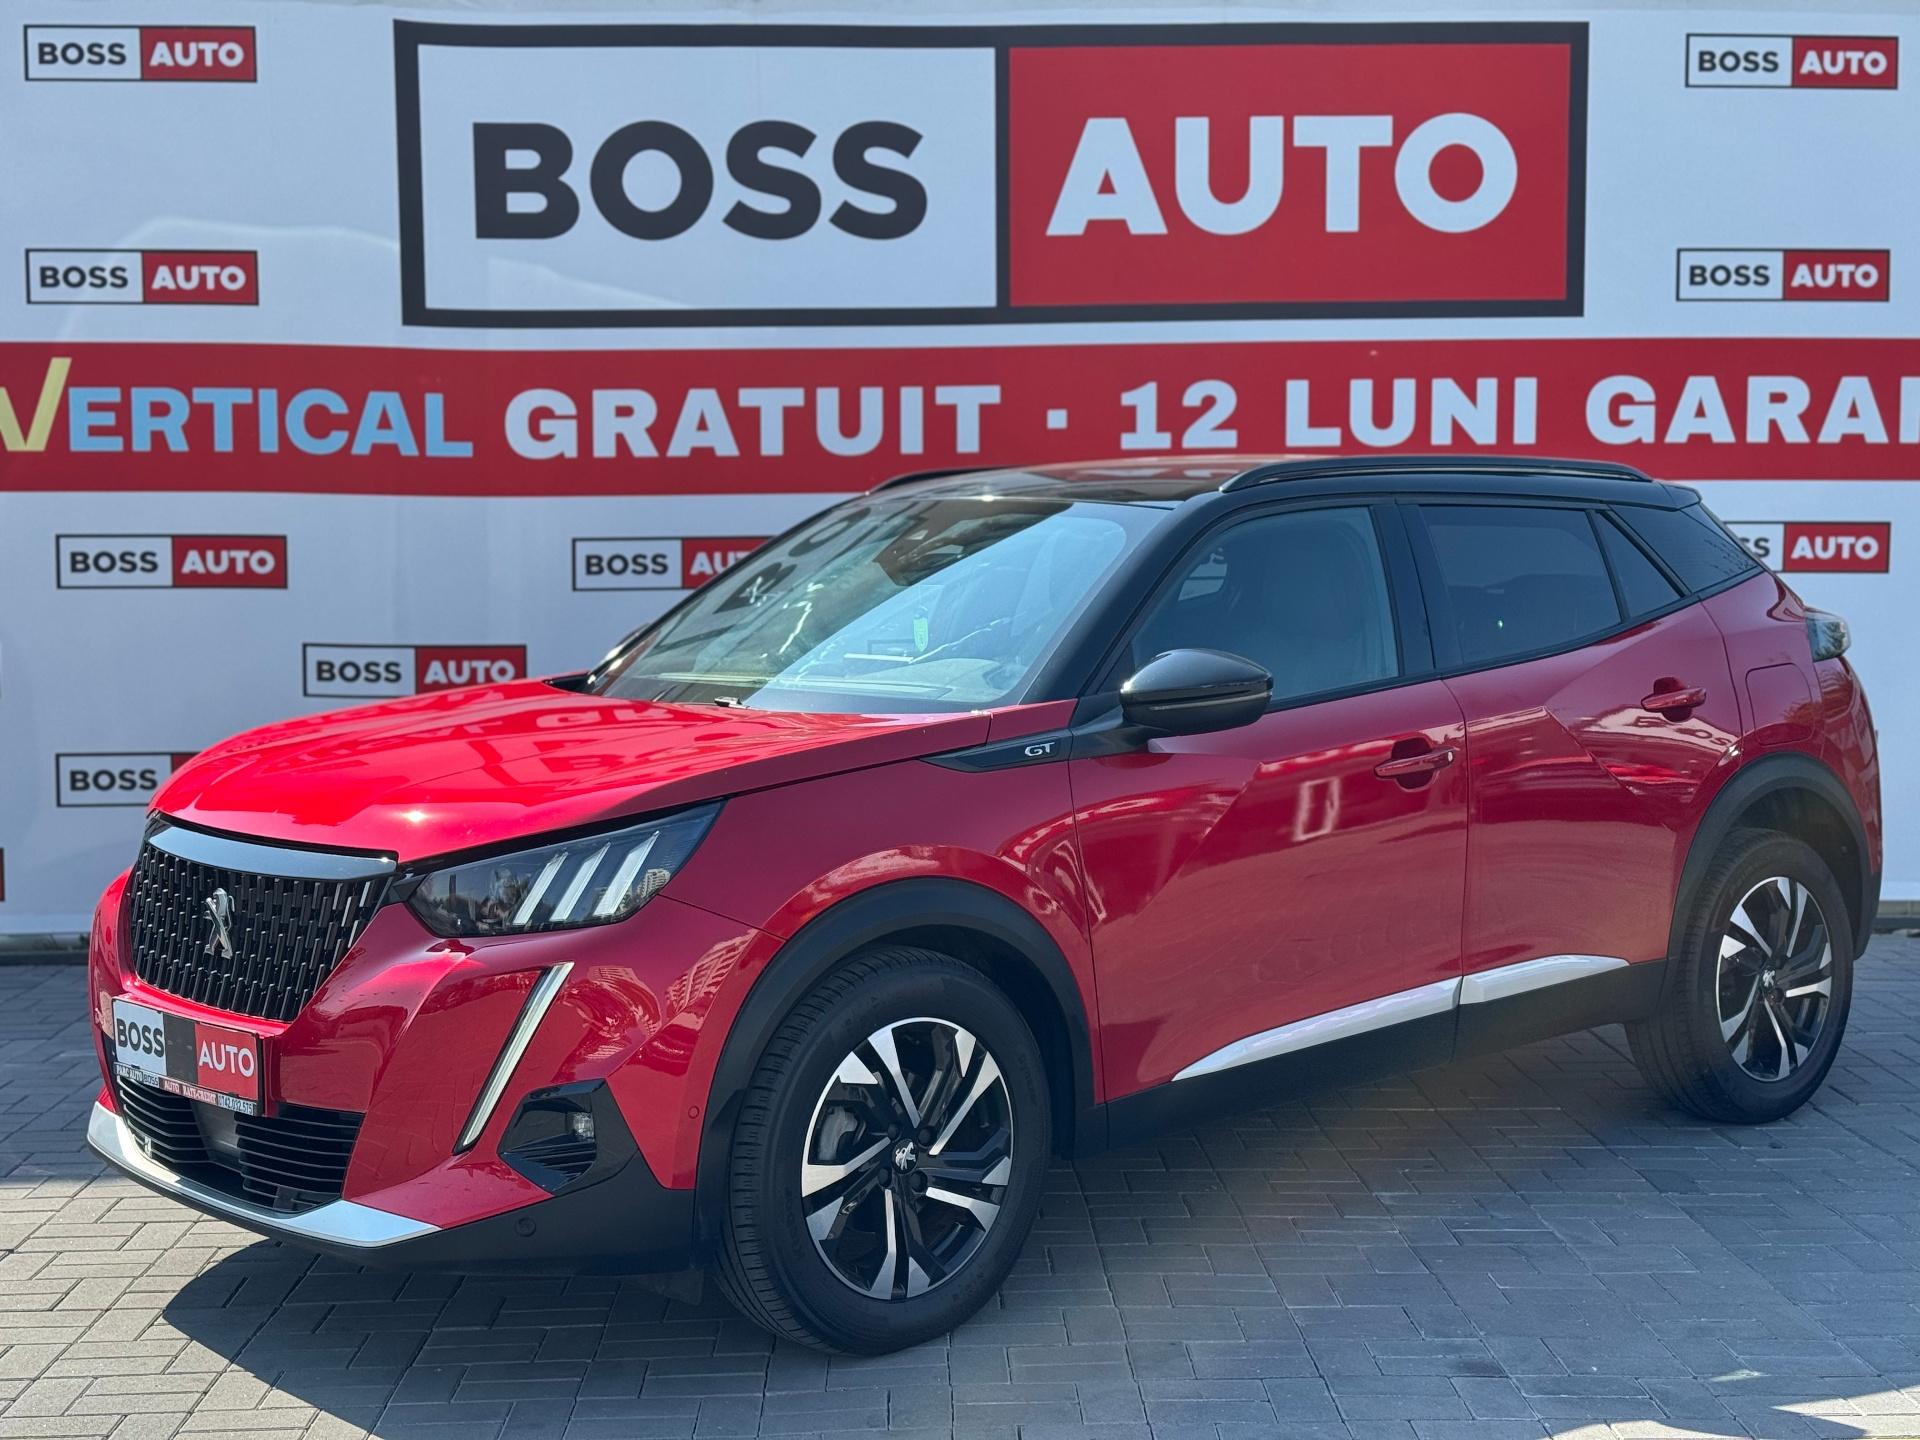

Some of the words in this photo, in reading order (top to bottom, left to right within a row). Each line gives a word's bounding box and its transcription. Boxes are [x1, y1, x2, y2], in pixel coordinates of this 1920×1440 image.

[38, 43, 127, 66] BOSS
[150, 42, 244, 67] AUTO
[1697, 50, 1780, 73] BOSS
[1800, 50, 1888, 75] AUTO
[472, 119, 928, 241] BOSS
[1045, 112, 1519, 236] AUTO
[39, 266, 129, 289] BOSS
[151, 265, 246, 291] AUTO
[1688, 264, 1771, 287] BOSS
[1791, 263, 1879, 289] AUTO
[503, 384, 1002, 460] GRATUIT
[1120, 380, 1238, 451] 12
[1285, 377, 1538, 448] LUNI
[1791, 536, 1879, 560] AUTO
[68, 550, 160, 574] BOSS
[181, 549, 275, 575] AUTO
[584, 553, 669, 576] BOSS
[316, 659, 402, 683] BOSS
[424, 659, 515, 684] AUTO
[1024, 742, 1056, 757] GT
[69, 769, 158, 792] BOSS
[116, 1018, 165, 1058] BOSS
[199, 1040, 255, 1078] AUTO
